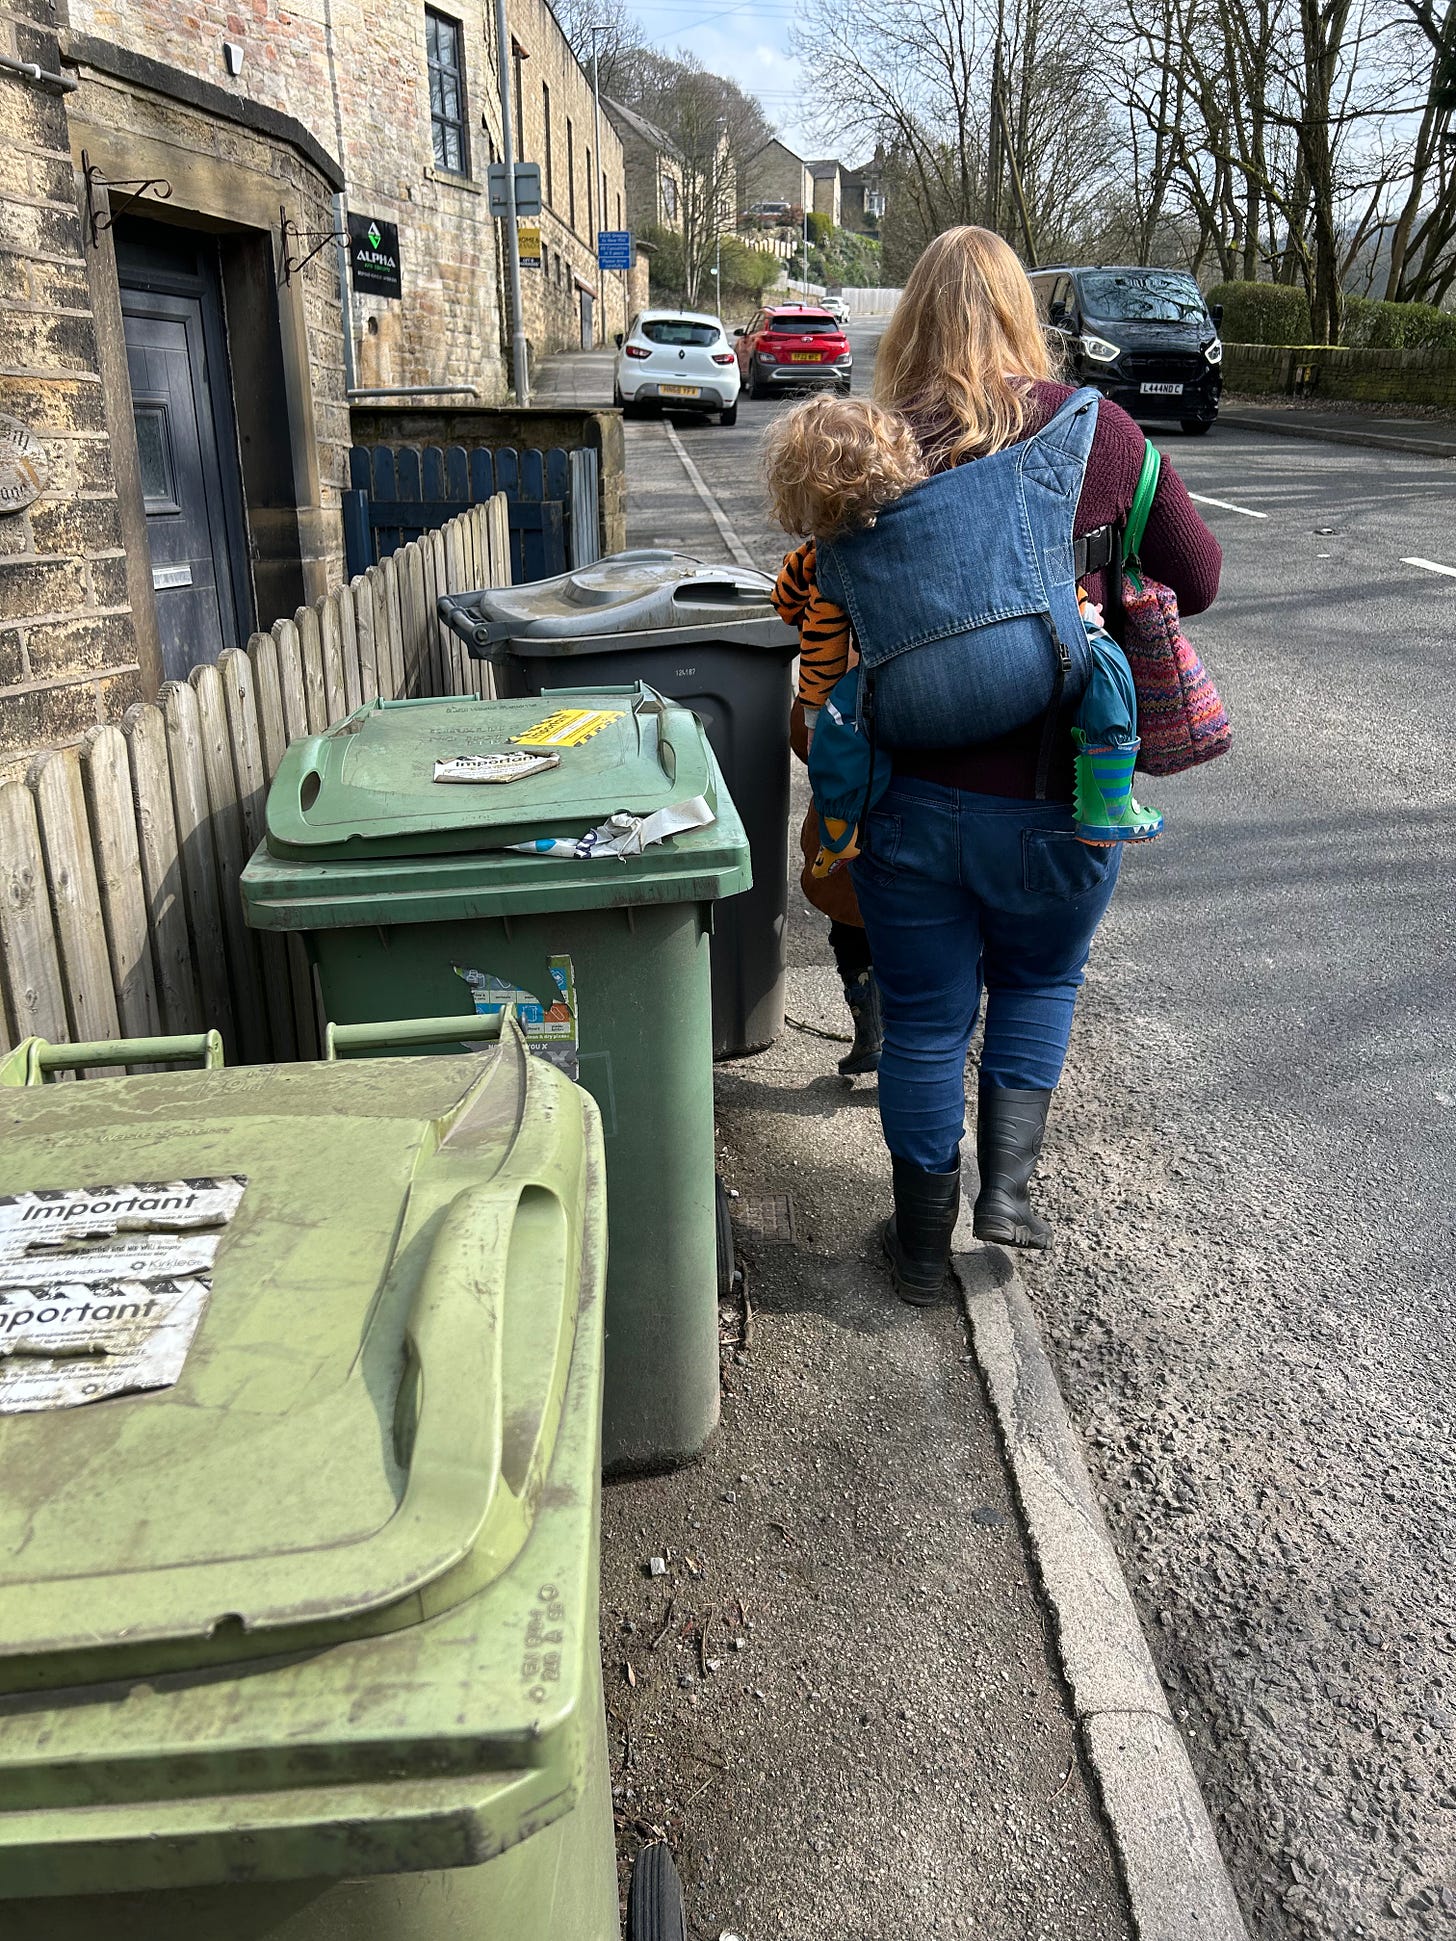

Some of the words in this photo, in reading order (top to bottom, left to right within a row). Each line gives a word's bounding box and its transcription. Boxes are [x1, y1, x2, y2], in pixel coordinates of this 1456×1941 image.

[357, 249, 396, 268] ALPHA
[22, 1193, 198, 1222] Important
[0, 1298, 159, 1333] portant
